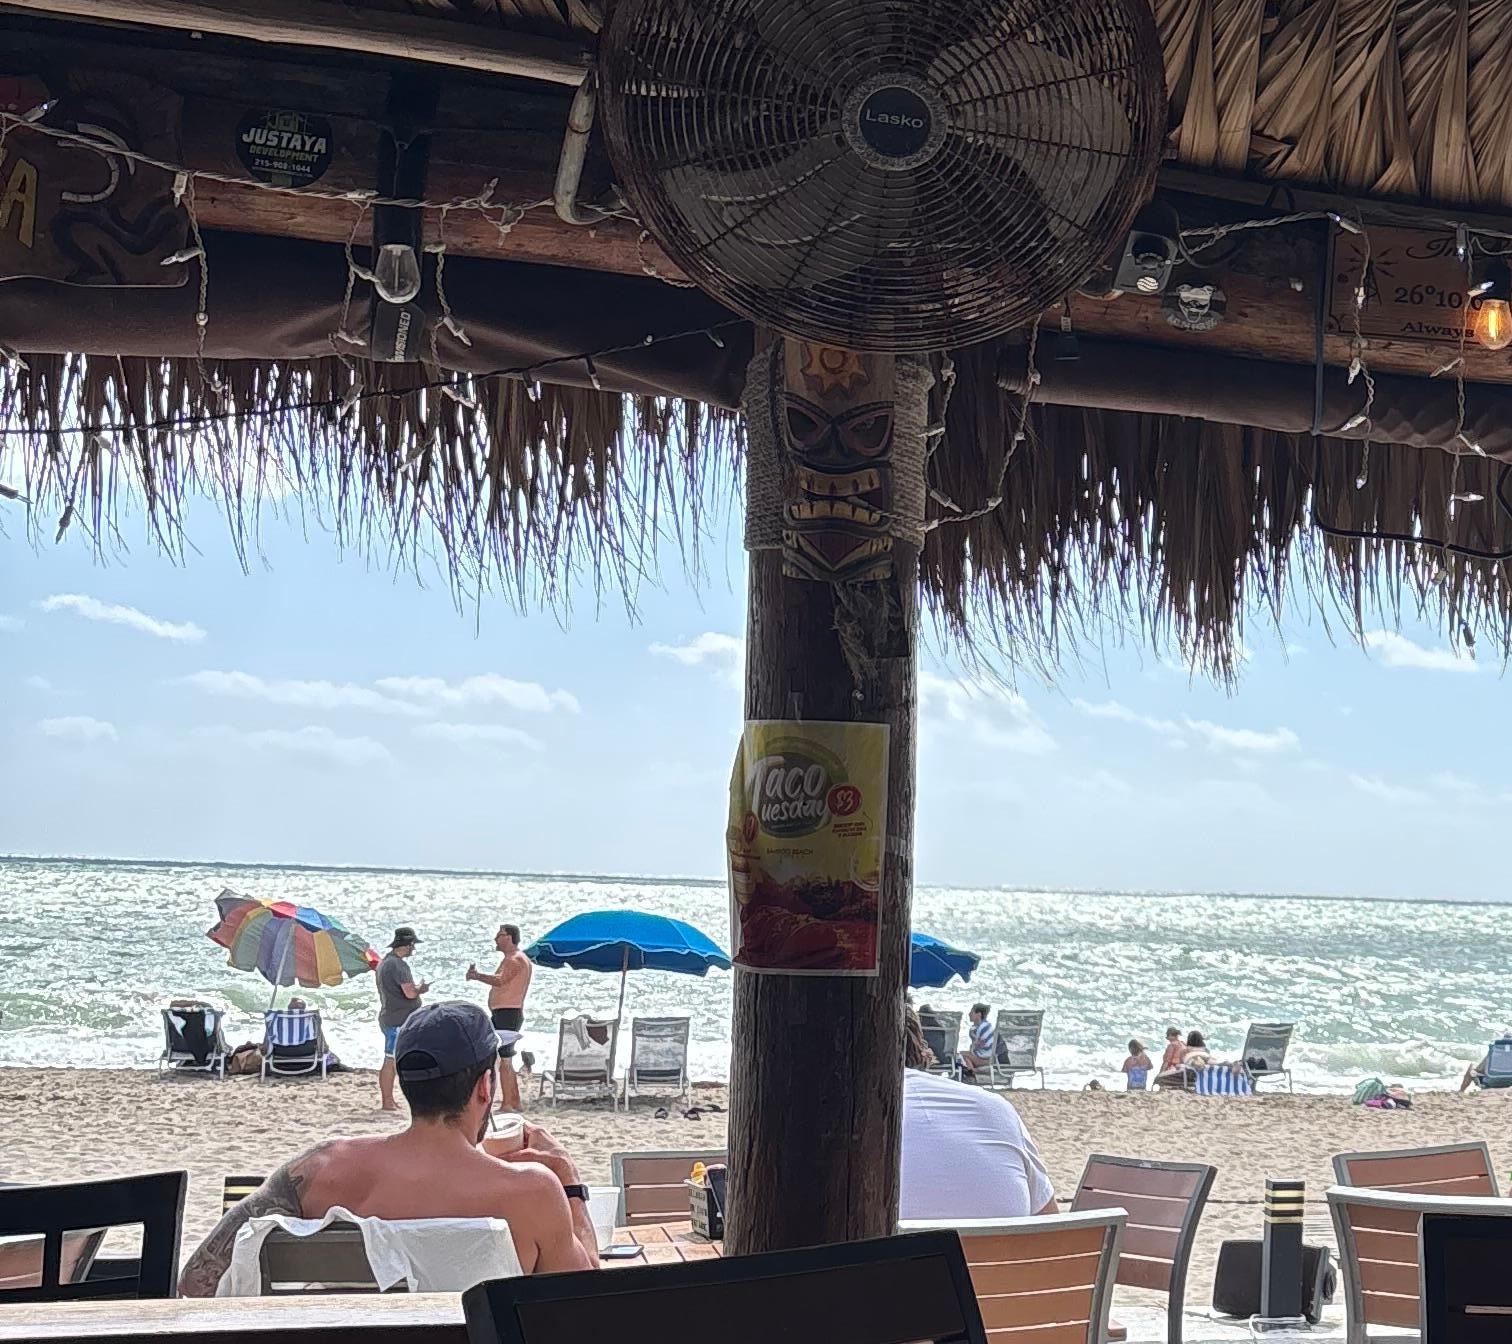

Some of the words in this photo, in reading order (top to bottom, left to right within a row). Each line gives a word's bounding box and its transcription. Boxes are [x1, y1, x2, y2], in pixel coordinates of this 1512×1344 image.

[866, 109, 924, 130] Lasko
[241, 127, 327, 154] JUSTAYA
[249, 145, 320, 163] DEVELOPMENT
[1400, 321, 1474, 338] Always
